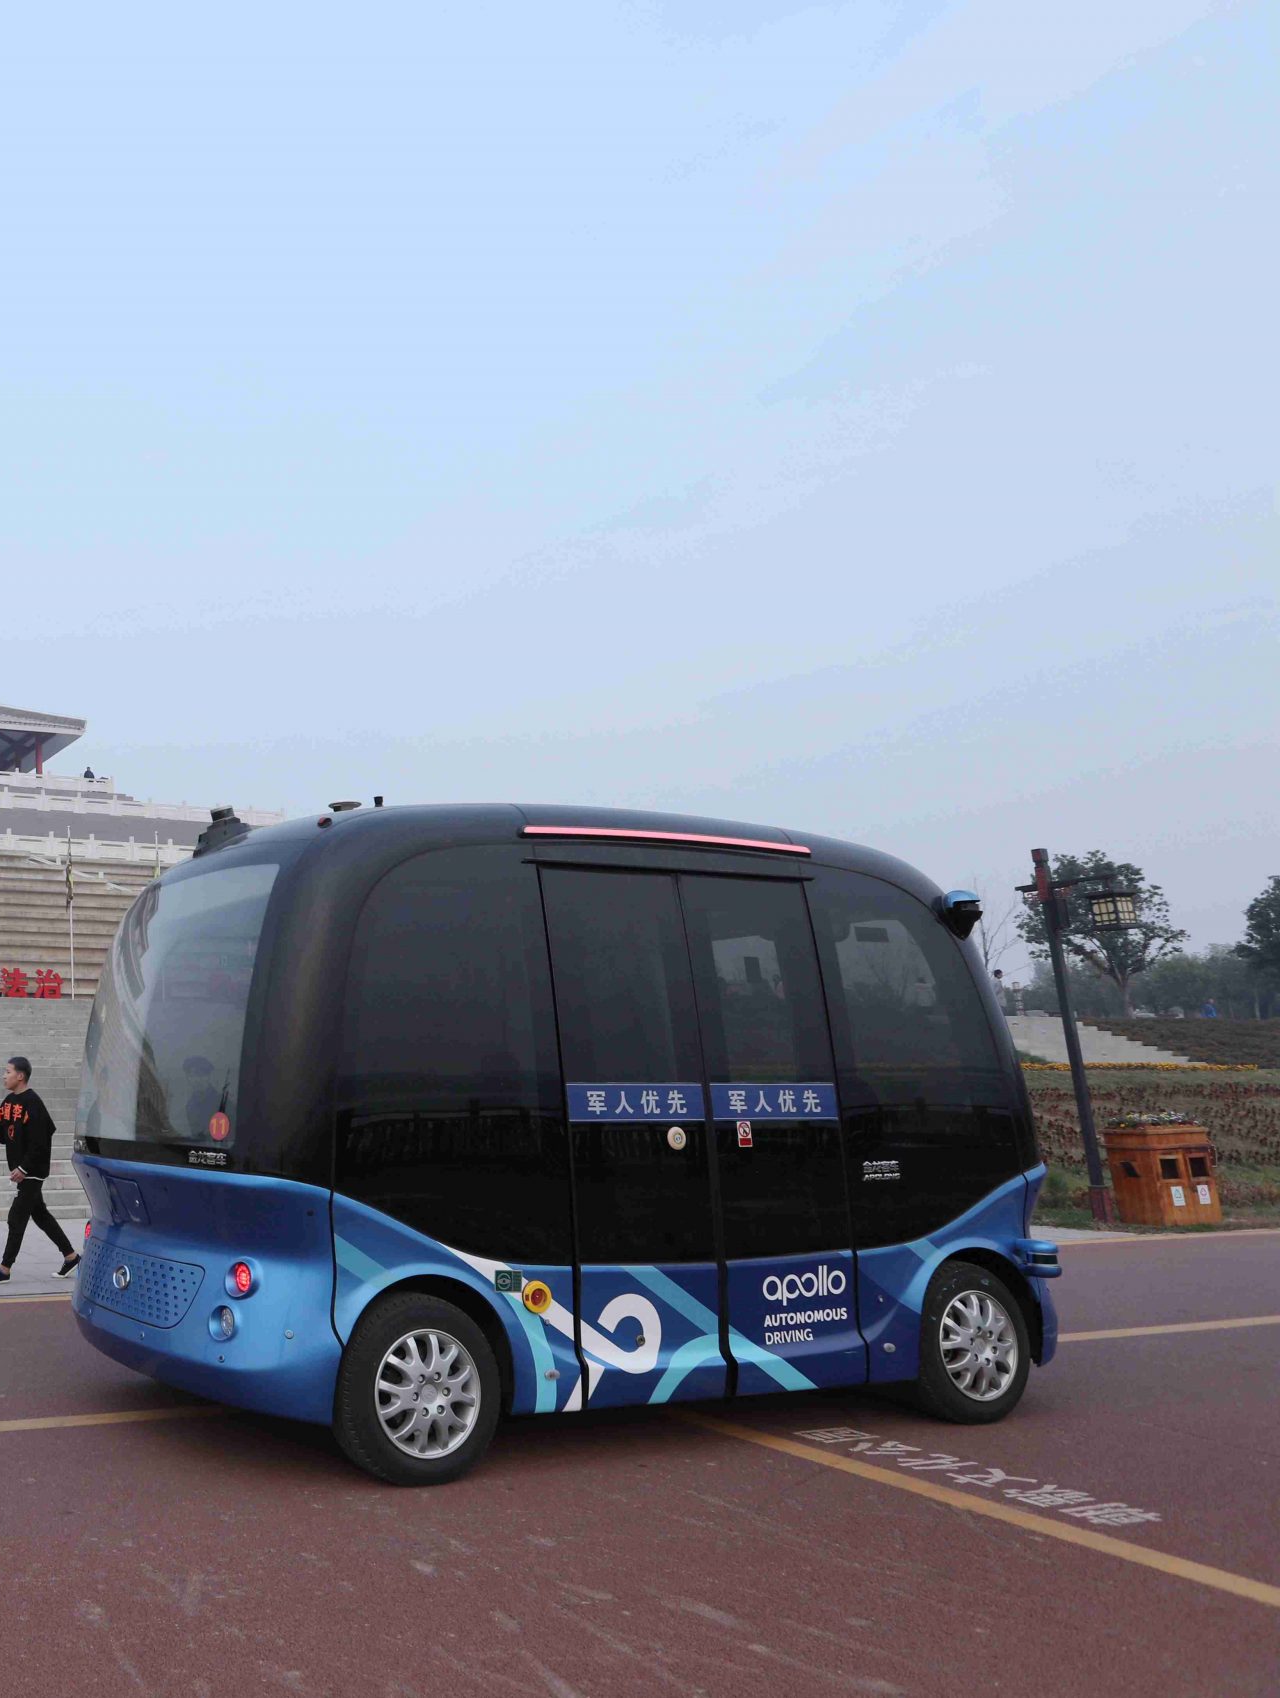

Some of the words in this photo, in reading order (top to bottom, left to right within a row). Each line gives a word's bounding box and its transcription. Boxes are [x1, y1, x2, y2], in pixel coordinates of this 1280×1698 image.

[0, 967, 65, 999] 法治
[586, 1089, 688, 1116] 军人优先
[728, 1089, 822, 1114] 军人优先
[211, 1118, 226, 1135] 11
[762, 1265, 847, 1306] apollo
[764, 1307, 848, 1328] AUTONOMOUS
[765, 1328, 814, 1346] DRIVING
